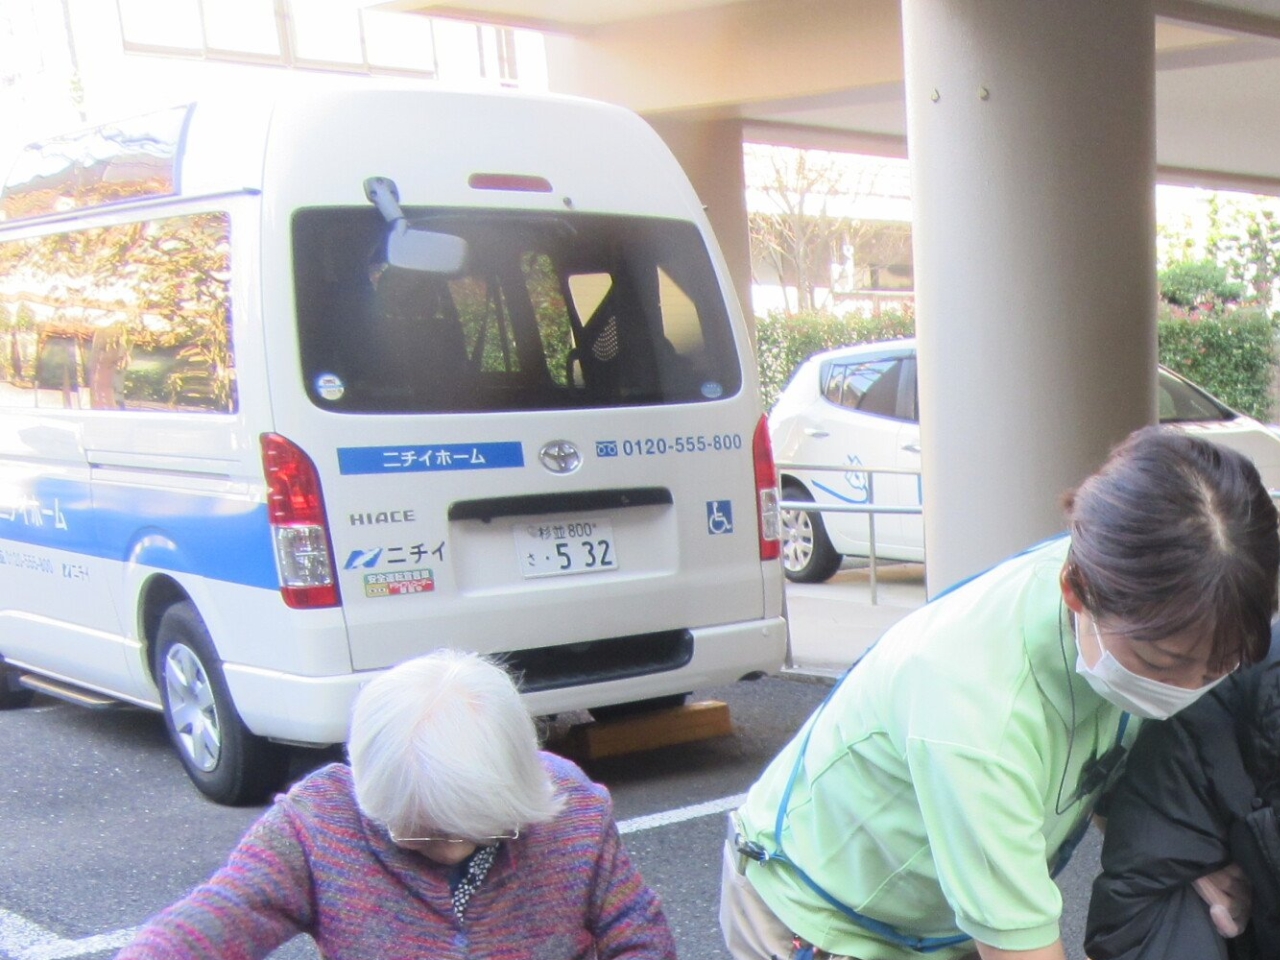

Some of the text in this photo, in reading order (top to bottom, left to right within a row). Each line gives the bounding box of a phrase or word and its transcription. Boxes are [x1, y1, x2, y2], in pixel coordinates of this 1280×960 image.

[622, 433, 742, 456] 0120-555-800
[382, 448, 486, 468] ニチイホーム
[349, 510, 416, 526] HIACE
[386, 541, 446, 564] ニチイ
